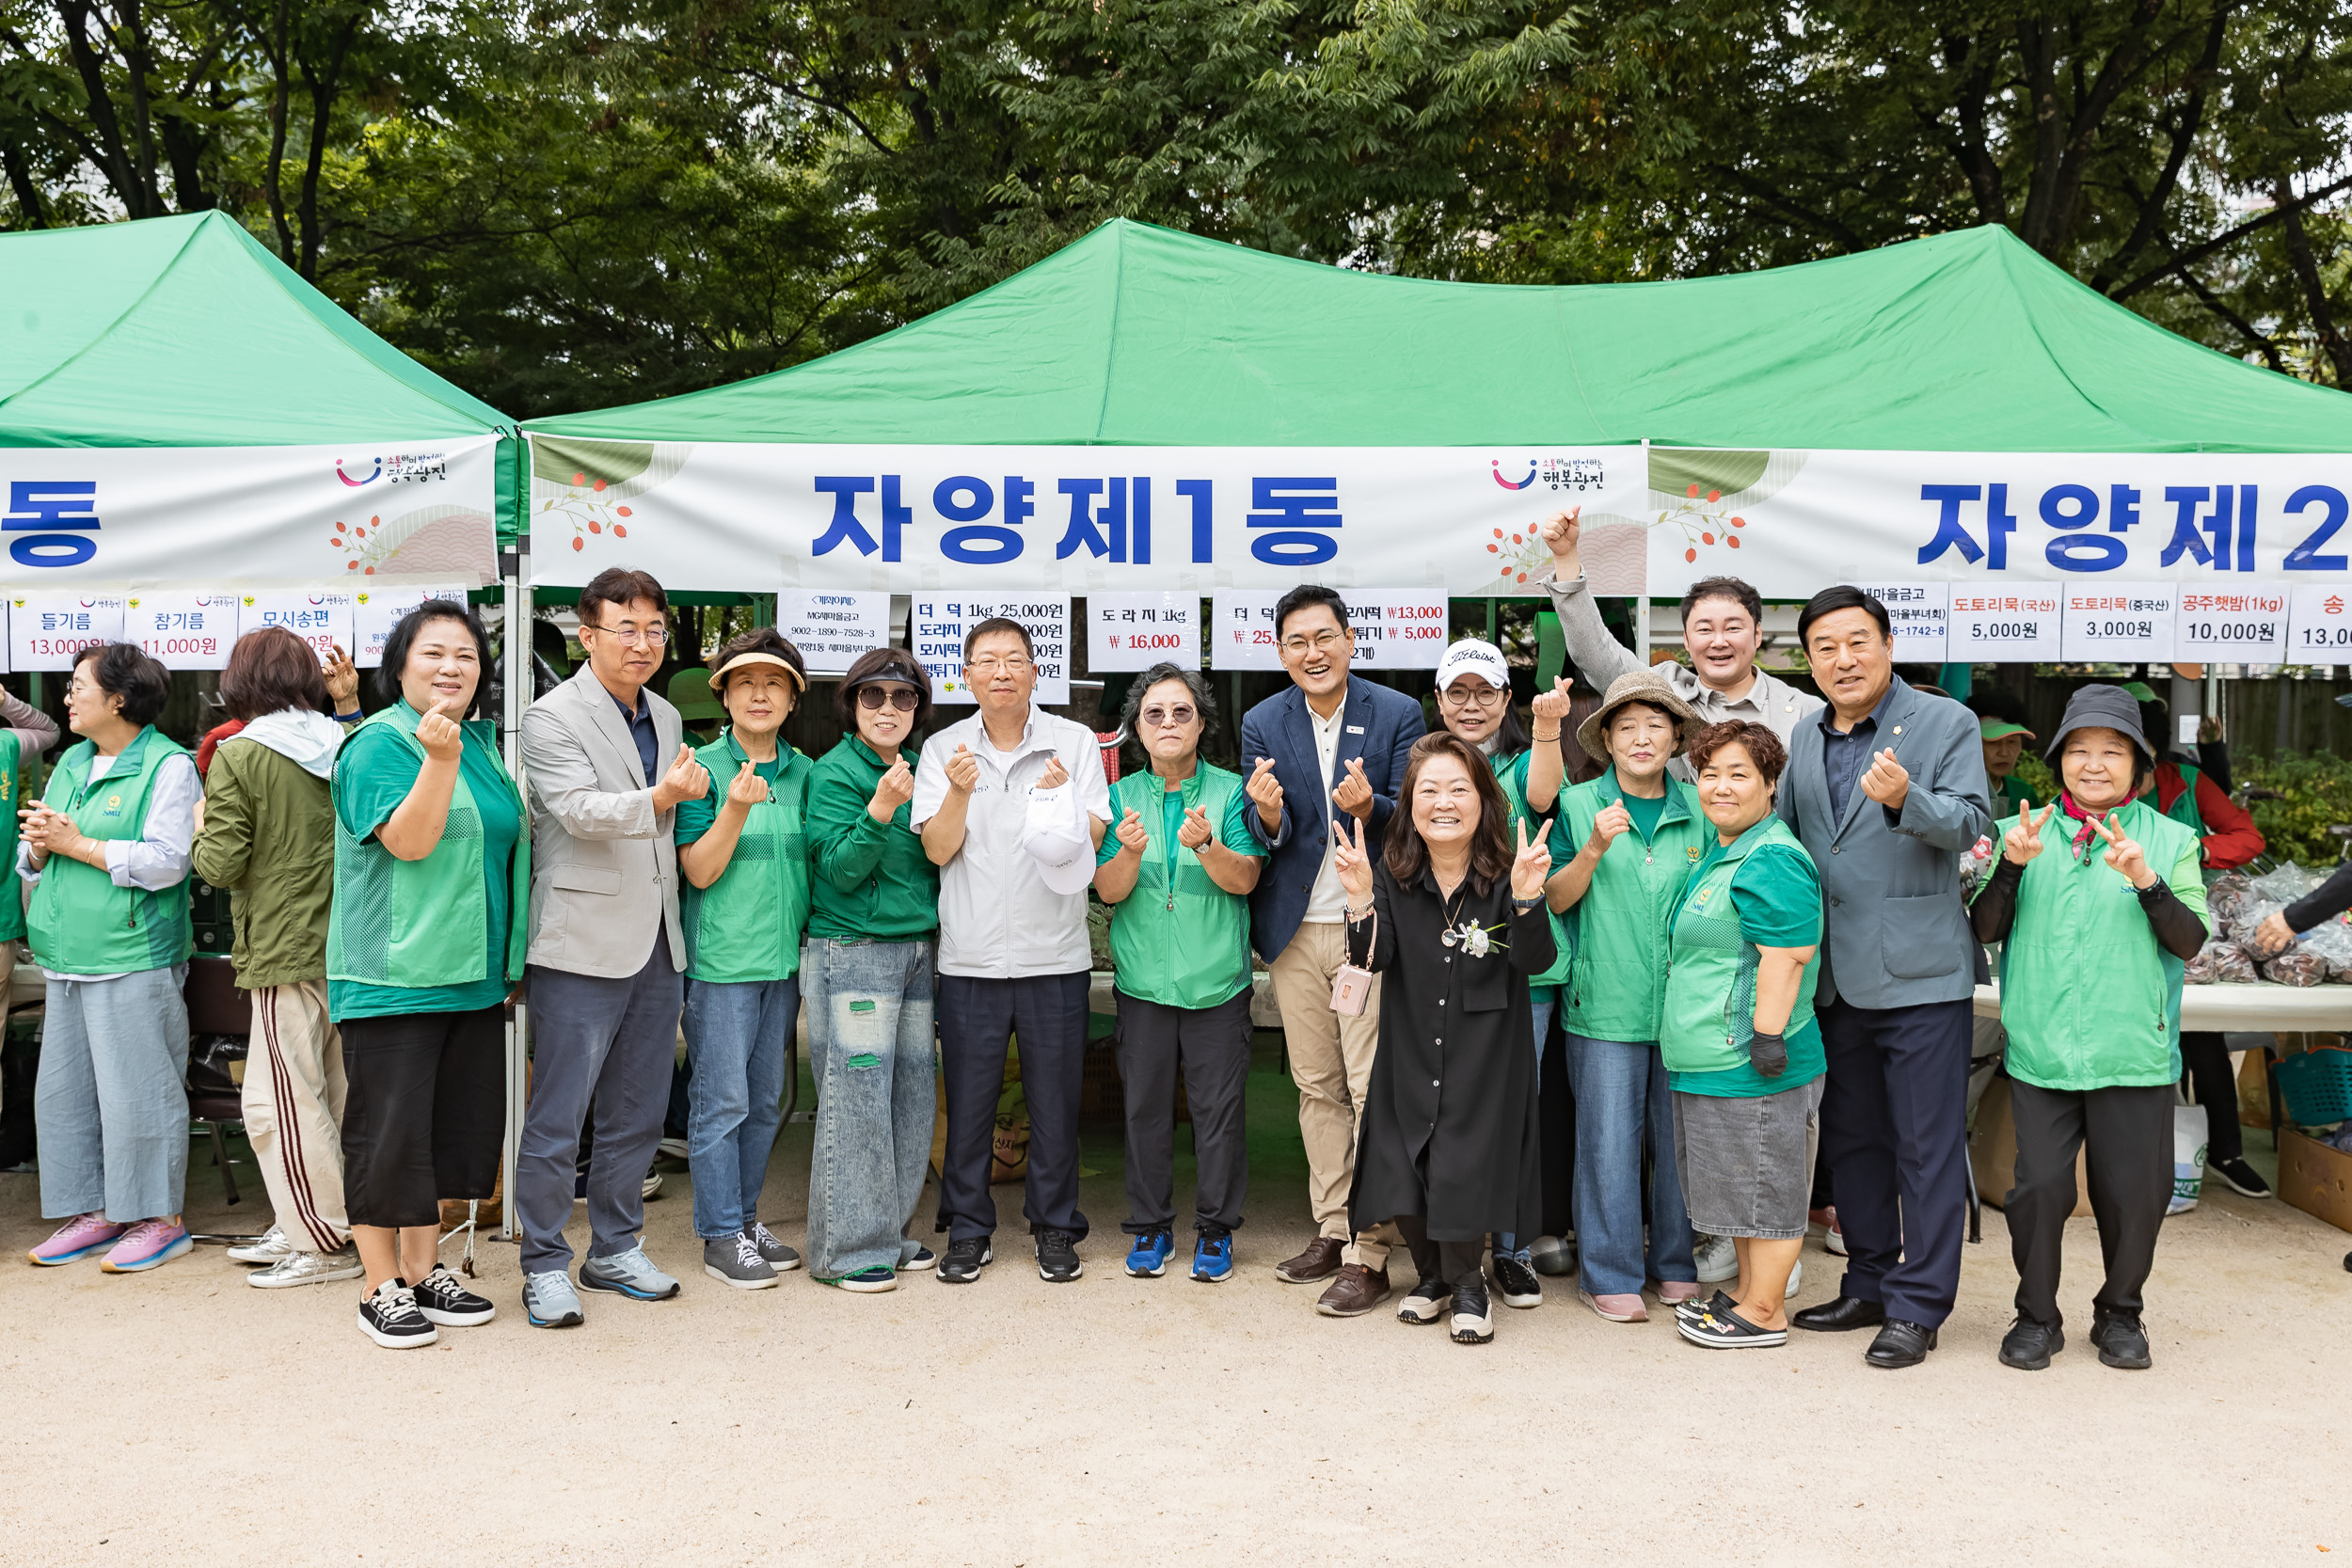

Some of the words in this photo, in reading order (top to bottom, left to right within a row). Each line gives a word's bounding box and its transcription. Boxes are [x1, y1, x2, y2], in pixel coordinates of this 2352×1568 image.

[1543, 458, 1571, 470] 소통하며
[1573, 459, 1603, 470] 발전하는
[1543, 469, 1603, 491] 행복광진
[1, 481, 102, 567] 동
[812, 474, 1343, 565] 자양제1동
[1917, 483, 2349, 572] 자양제2
[969, 604, 993, 619] 1kg
[1000, 604, 1063, 619] 25,000원
[2323, 594, 2344, 614] 송
[41, 613, 91, 630] 들기름
[154, 612, 204, 630] 참기름
[262, 610, 328, 628] 모시송편
[807, 611, 859, 621] MG새마을금고
[1163, 610, 1186, 623] 1kg
[1887, 609, 1946, 620] 마을부녀회)
[791, 626, 875, 638] 9002-1890-7528-3
[919, 624, 961, 638] 도라지
[1353, 626, 1382, 640] 튀기
[1405, 626, 1442, 641] 5,000
[1892, 626, 1945, 636] 6-1742-8
[1972, 623, 2038, 640] 5,000원
[2087, 621, 2153, 638] 3,000원
[2188, 623, 2275, 642] 10,000원
[2303, 628, 2352, 647] 13,0
[143, 638, 216, 656] 11,000원
[920, 644, 961, 657] 모시떡
[1129, 634, 1181, 651] 16,000
[1352, 646, 1375, 660] 2개)
[1448, 649, 1496, 667] Titleist
[993, 1137, 1014, 1150] 산지
